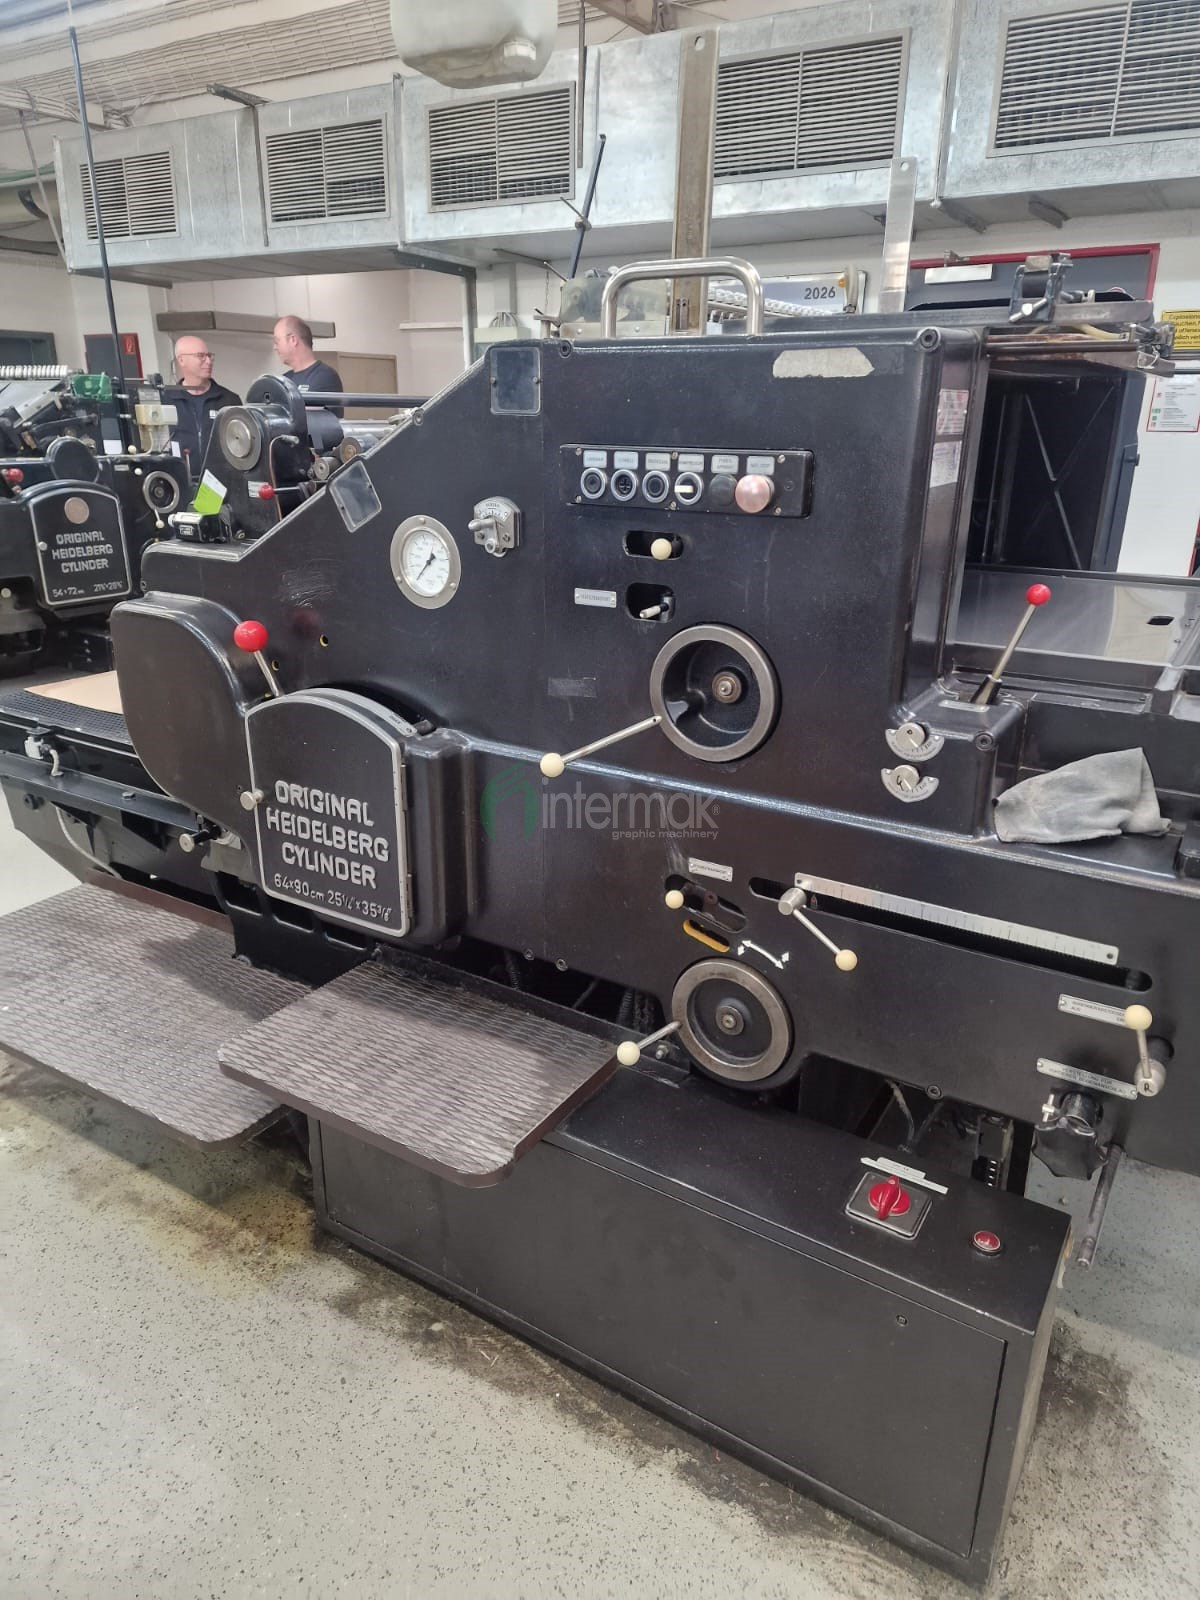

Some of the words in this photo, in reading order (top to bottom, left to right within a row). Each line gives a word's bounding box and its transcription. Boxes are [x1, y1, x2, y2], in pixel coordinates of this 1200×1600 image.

[804, 286, 836, 300] 2026
[56, 531, 105, 545] ORIGINAL
[52, 544, 114, 560] HEIDELBERG
[61, 558, 109, 573] CYLINDER
[275, 780, 374, 827] ORIGINAL
[266, 806, 389, 862] HEIDELBERG
[282, 841, 377, 889] CYLINDER
